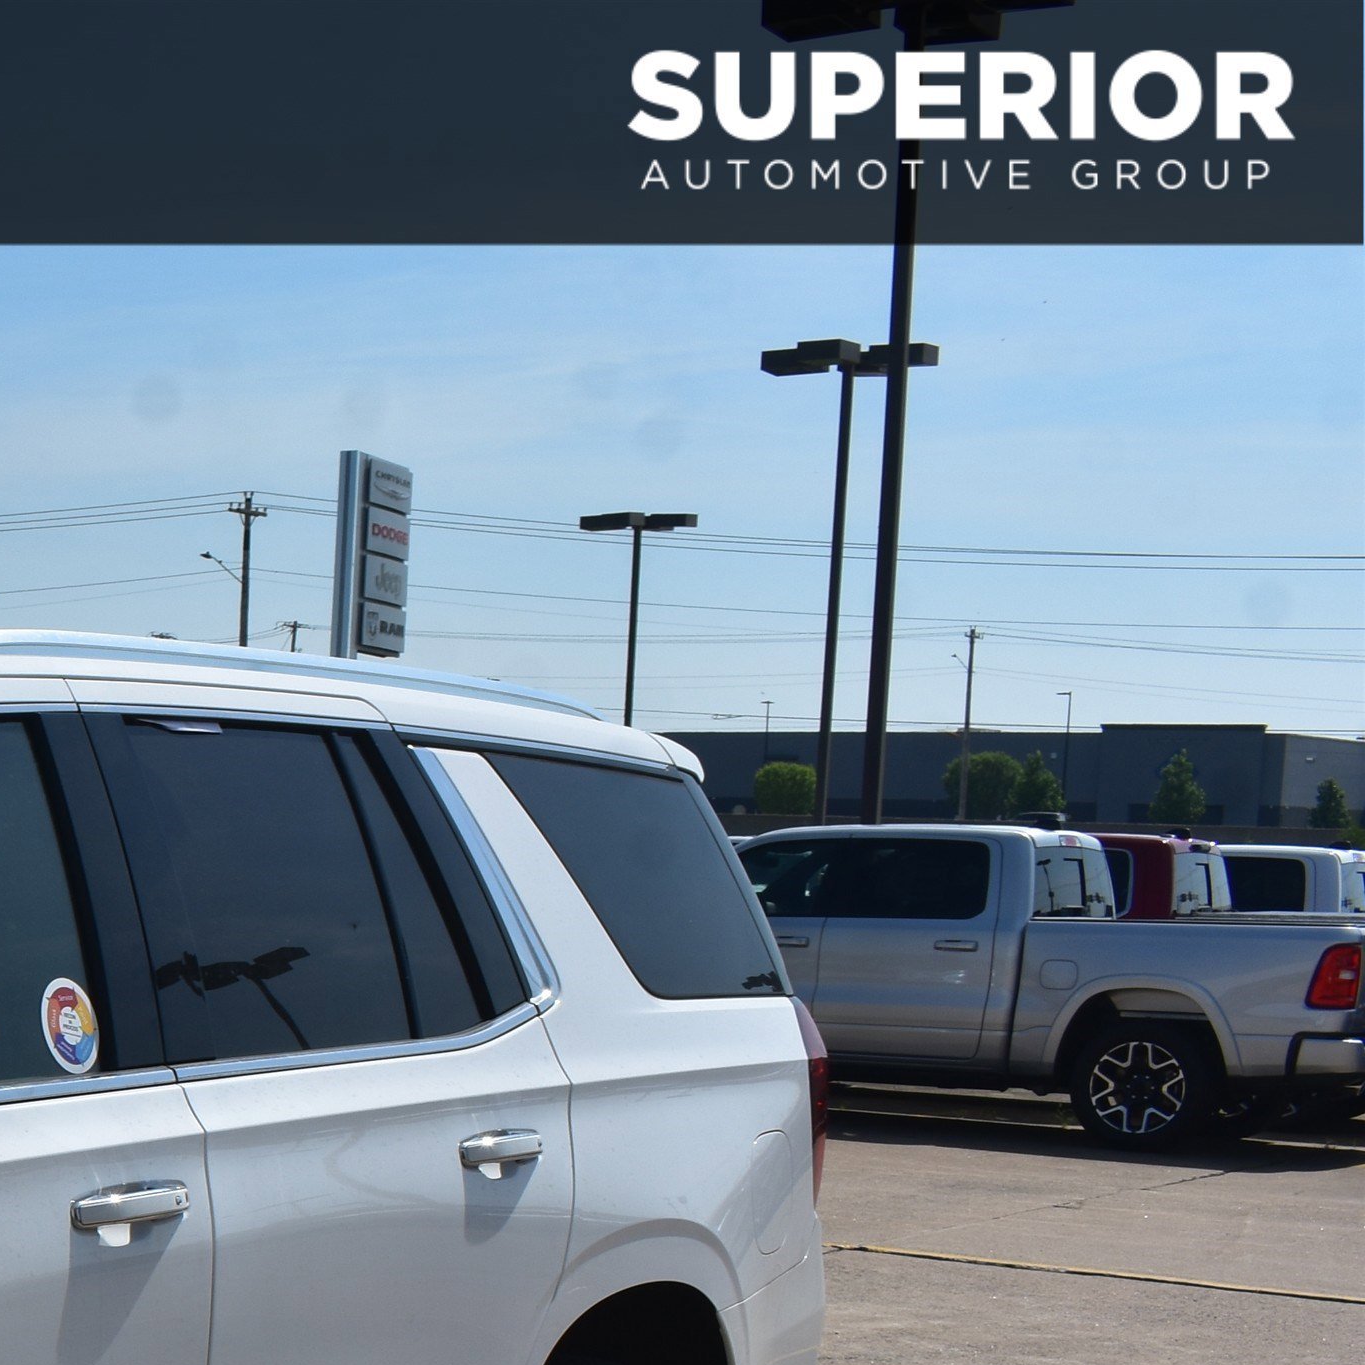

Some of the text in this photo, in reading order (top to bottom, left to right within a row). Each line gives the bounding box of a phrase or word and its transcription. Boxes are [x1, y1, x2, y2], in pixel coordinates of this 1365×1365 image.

[372, 523, 409, 546] DODGE
[375, 563, 402, 600] Jeep
[379, 620, 405, 638] RAM
